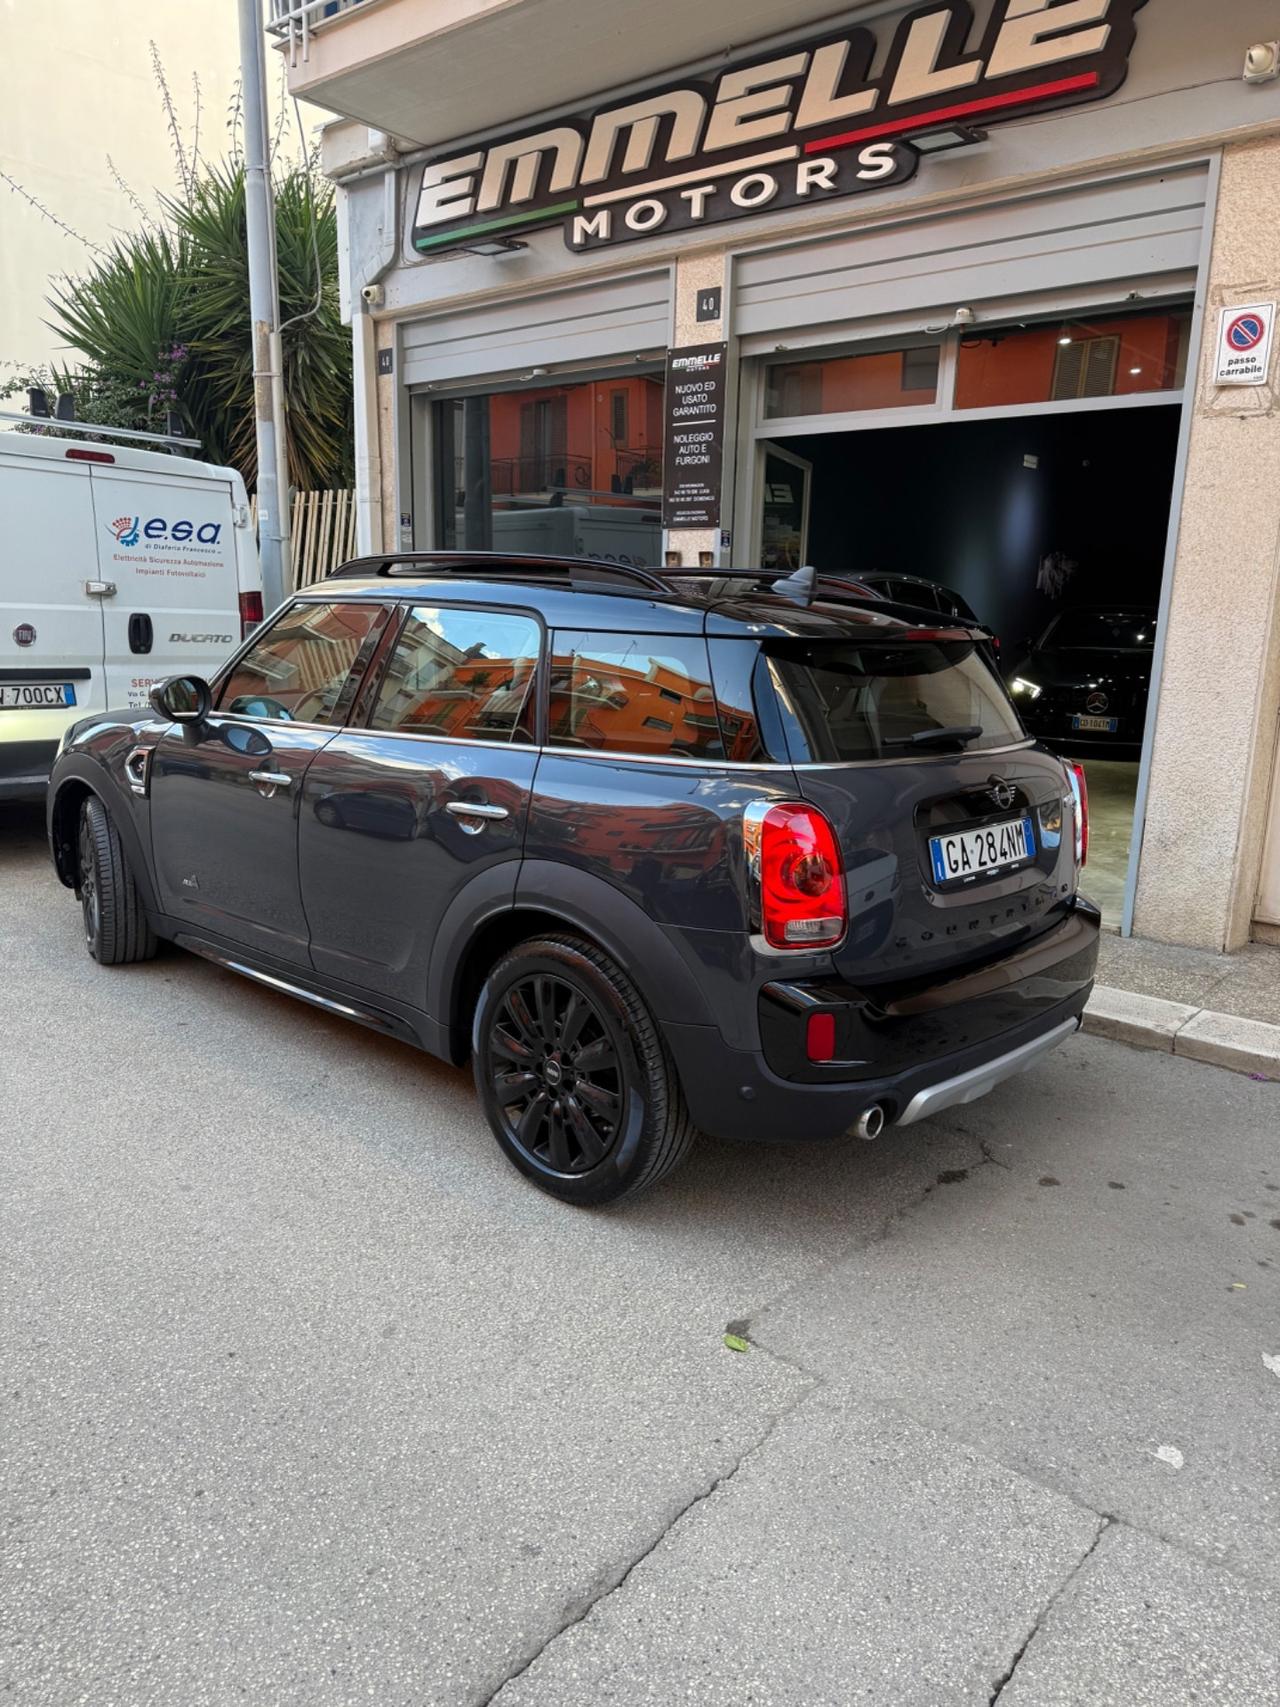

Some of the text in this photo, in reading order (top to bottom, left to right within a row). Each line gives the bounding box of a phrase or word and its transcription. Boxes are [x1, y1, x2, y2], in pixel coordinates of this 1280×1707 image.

[415, 0, 1112, 228] EMMELLE
[572, 142, 899, 245] MOTORS
[672, 353, 721, 368] EMMELLE
[1228, 355, 1256, 366] passo
[1219, 366, 1262, 376] carrabile
[675, 381, 716, 394] NUOVO ED
[682, 393, 708, 405] USATO
[672, 403, 717, 416] GARANTITO
[673, 432, 714, 444] NOLEGGIO
[679, 443, 707, 455] AUTO E
[675, 455, 711, 466] FURGONI
[144, 518, 222, 544] e.s.a.
[113, 554, 224, 568] Elettricità Sicurezza Automazione
[135, 567, 207, 578] Impianti Fotovoltaici
[168, 633, 233, 643] DUCATO
[12, 686, 65, 704] 700CX
